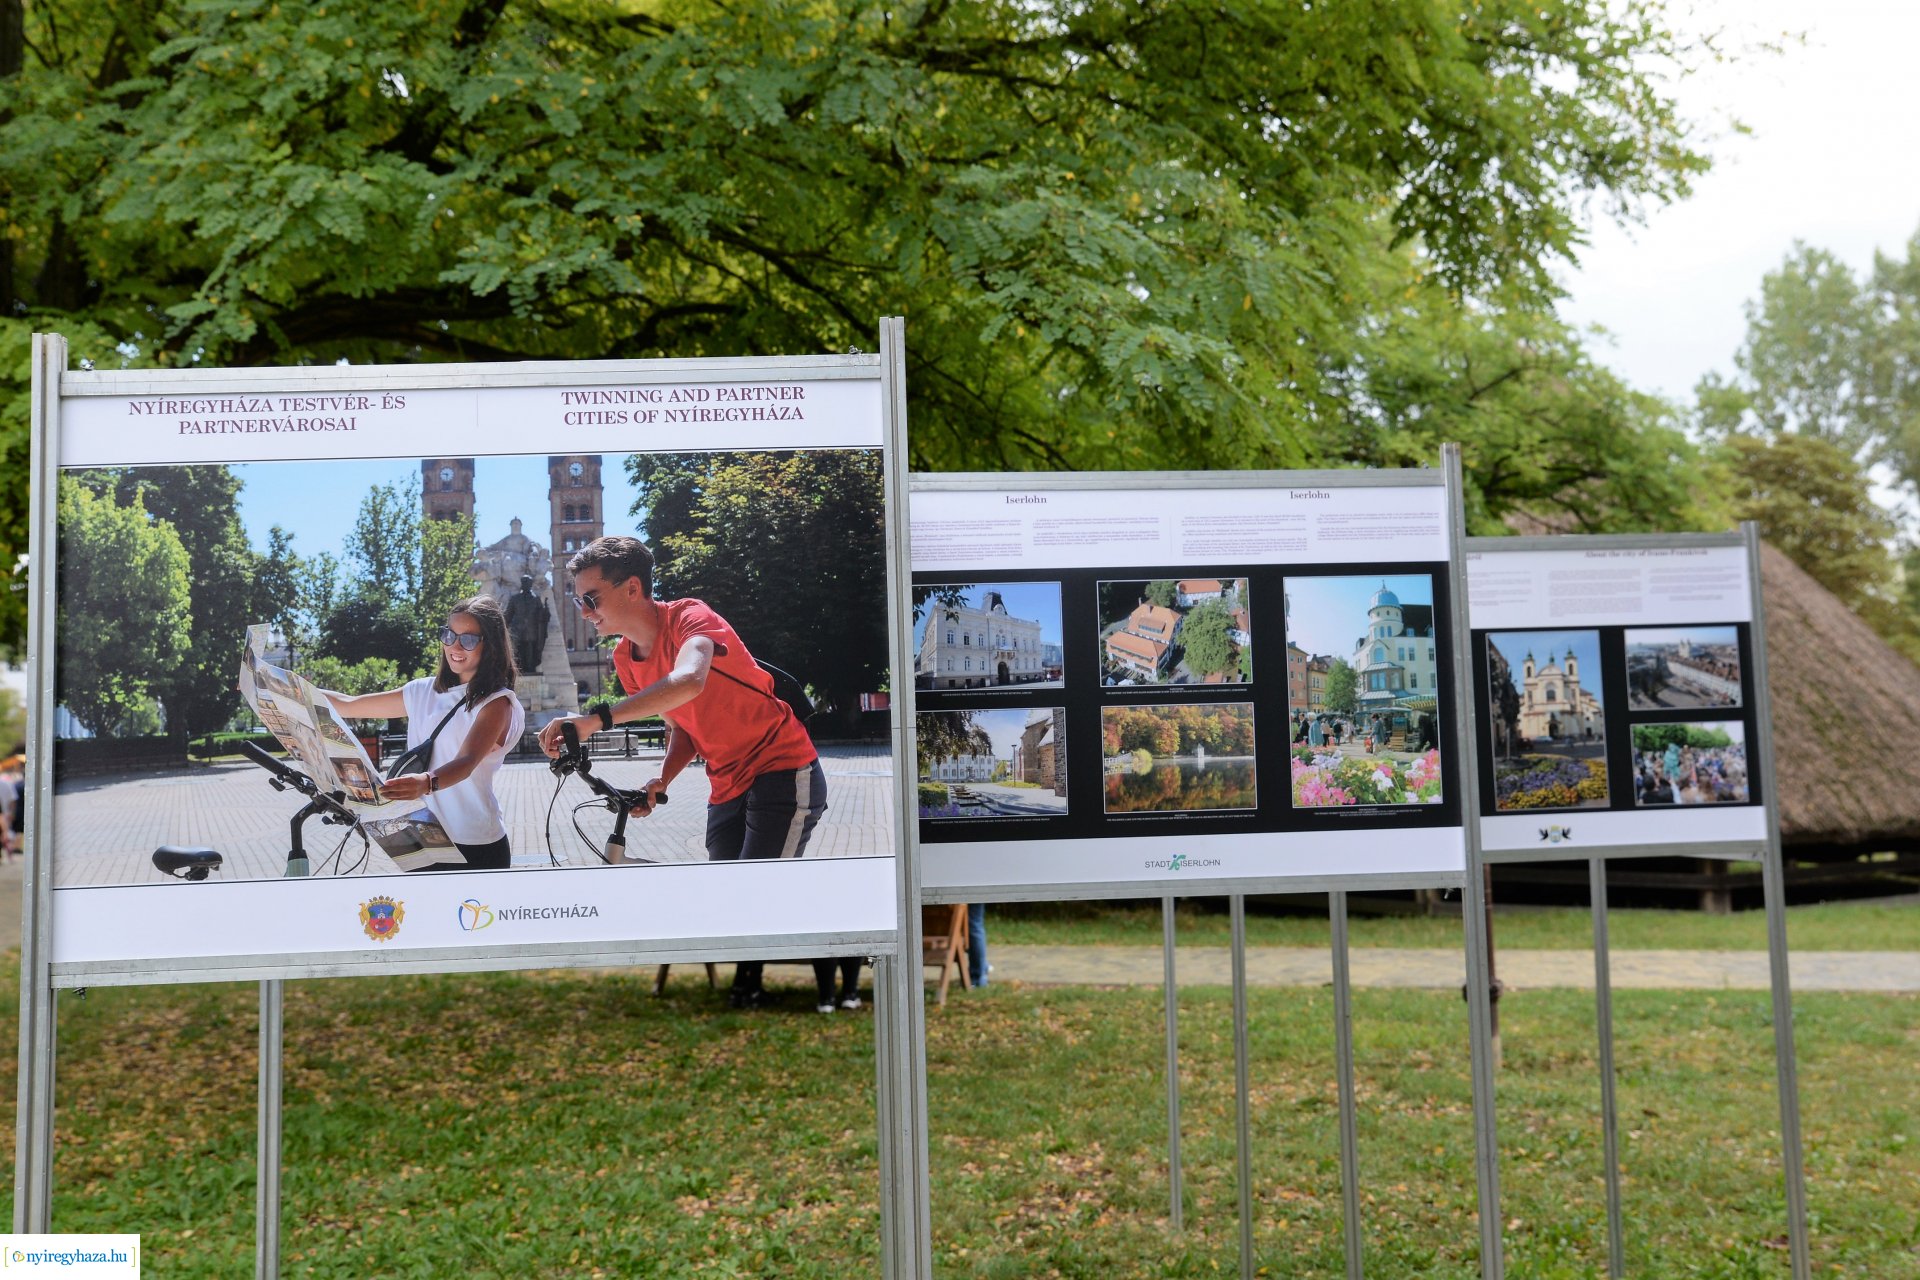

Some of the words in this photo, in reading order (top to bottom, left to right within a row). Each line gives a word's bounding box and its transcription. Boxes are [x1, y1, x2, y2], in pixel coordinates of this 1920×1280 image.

[128, 396, 274, 415] NYÍREGYHÁZA
[278, 393, 376, 412] TESTVÉR-
[381, 392, 406, 409] ÉS
[561, 389, 663, 406] TWINNING
[667, 388, 710, 403] AND
[715, 386, 806, 402] PARTNER
[564, 410, 628, 426] CITIES
[633, 409, 659, 424] OF
[664, 404, 804, 423] NYÍREGYHÁZA
[178, 415, 357, 435] PARTNERVÁROSAI
[1005, 494, 1048, 505] Iserlohn
[1289, 489, 1331, 501] Iserlohn
[1145, 860, 1171, 869] STADT
[1180, 859, 1221, 868] ISERLOHN
[498, 904, 599, 921] NYÍREGYHÁZA
